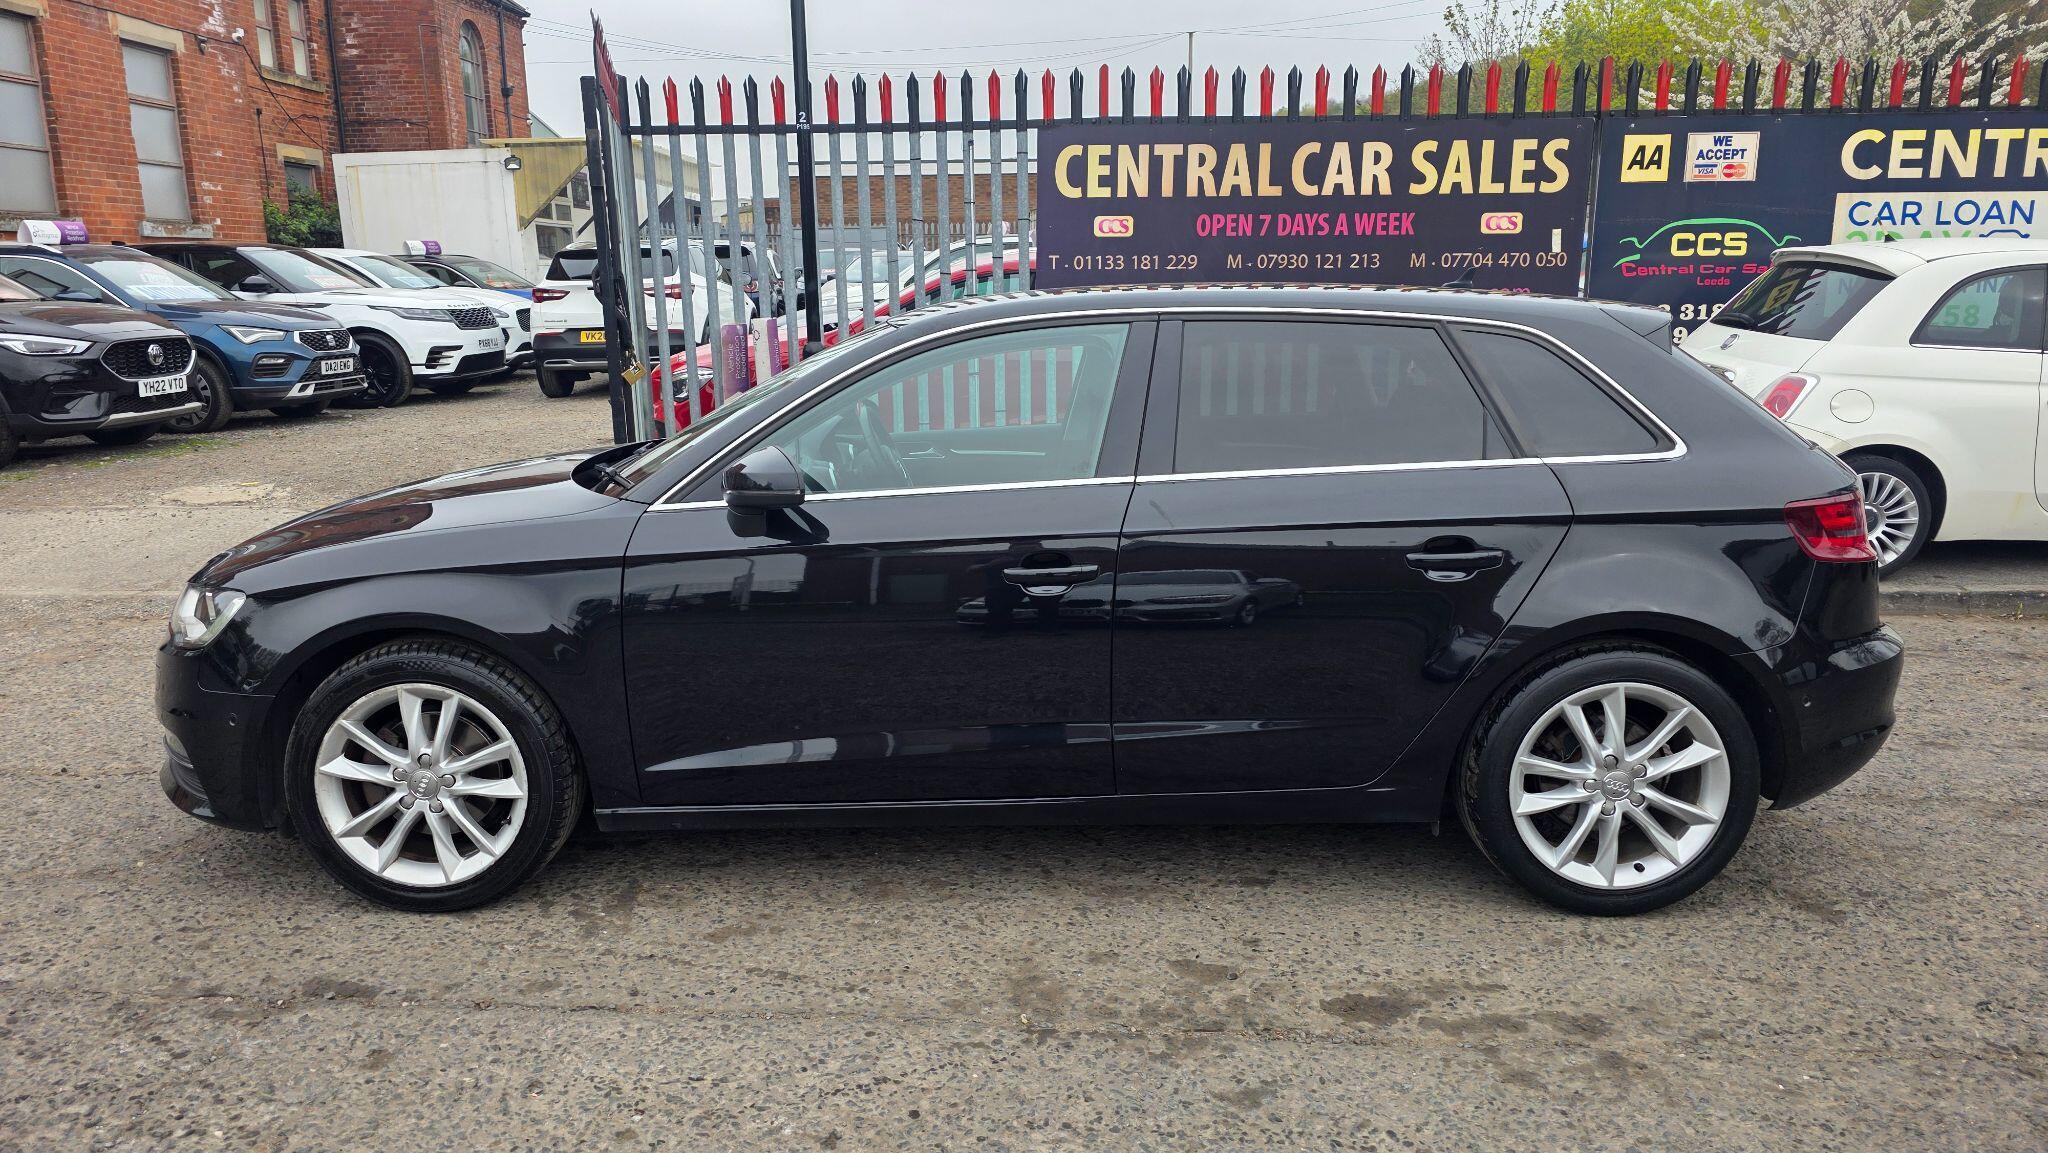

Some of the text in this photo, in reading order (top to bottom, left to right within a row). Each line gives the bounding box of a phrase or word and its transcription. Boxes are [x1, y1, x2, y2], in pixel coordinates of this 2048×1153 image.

[798, 112, 807, 123] 2
[1713, 135, 1733, 147] WE
[1626, 144, 1664, 171] AA
[1696, 148, 1748, 160] ACCEPT
[1054, 138, 1570, 198] CENTRAL CAR SALES
[1848, 199, 2036, 227] CAR LOAN
[1098, 218, 1130, 235] CCS
[1196, 212, 1415, 237] OPEN 7 DAYS A WEEK
[1485, 215, 1518, 231] CCS
[1670, 231, 1748, 257] CCS
[1073, 255, 1125, 270] 01133
[1131, 255, 1159, 270] 181
[1166, 254, 1198, 270] 229
[1257, 253, 1309, 269] 07930
[1315, 253, 1342, 269] 121
[1349, 253, 1381, 269] 213
[1441, 253, 1493, 268] 07704
[1498, 252, 1530, 268] 470
[1535, 252, 1567, 268] 050
[1621, 262, 1694, 278] Central
[1699, 264, 1737, 274] Car
[1696, 276, 1731, 286] Leeds
[143, 378, 184, 393] YH22 VTO
